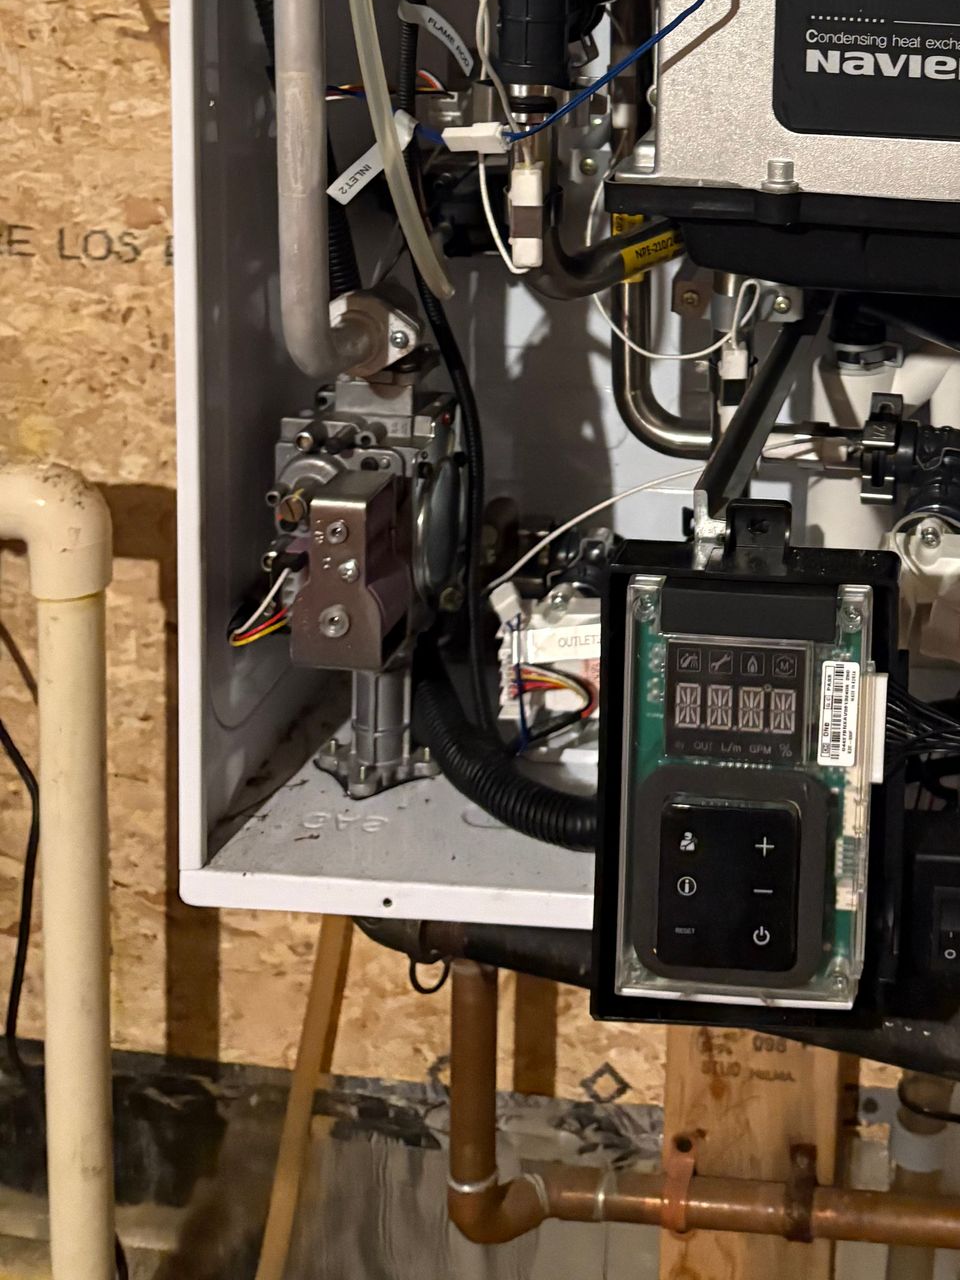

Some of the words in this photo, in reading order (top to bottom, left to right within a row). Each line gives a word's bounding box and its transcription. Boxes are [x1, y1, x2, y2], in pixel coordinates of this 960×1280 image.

[805, 29, 888, 48] Condensing
[892, 35, 921, 48] heat
[0, 224, 36, 257] E
[57, 227, 141, 263] LOS
